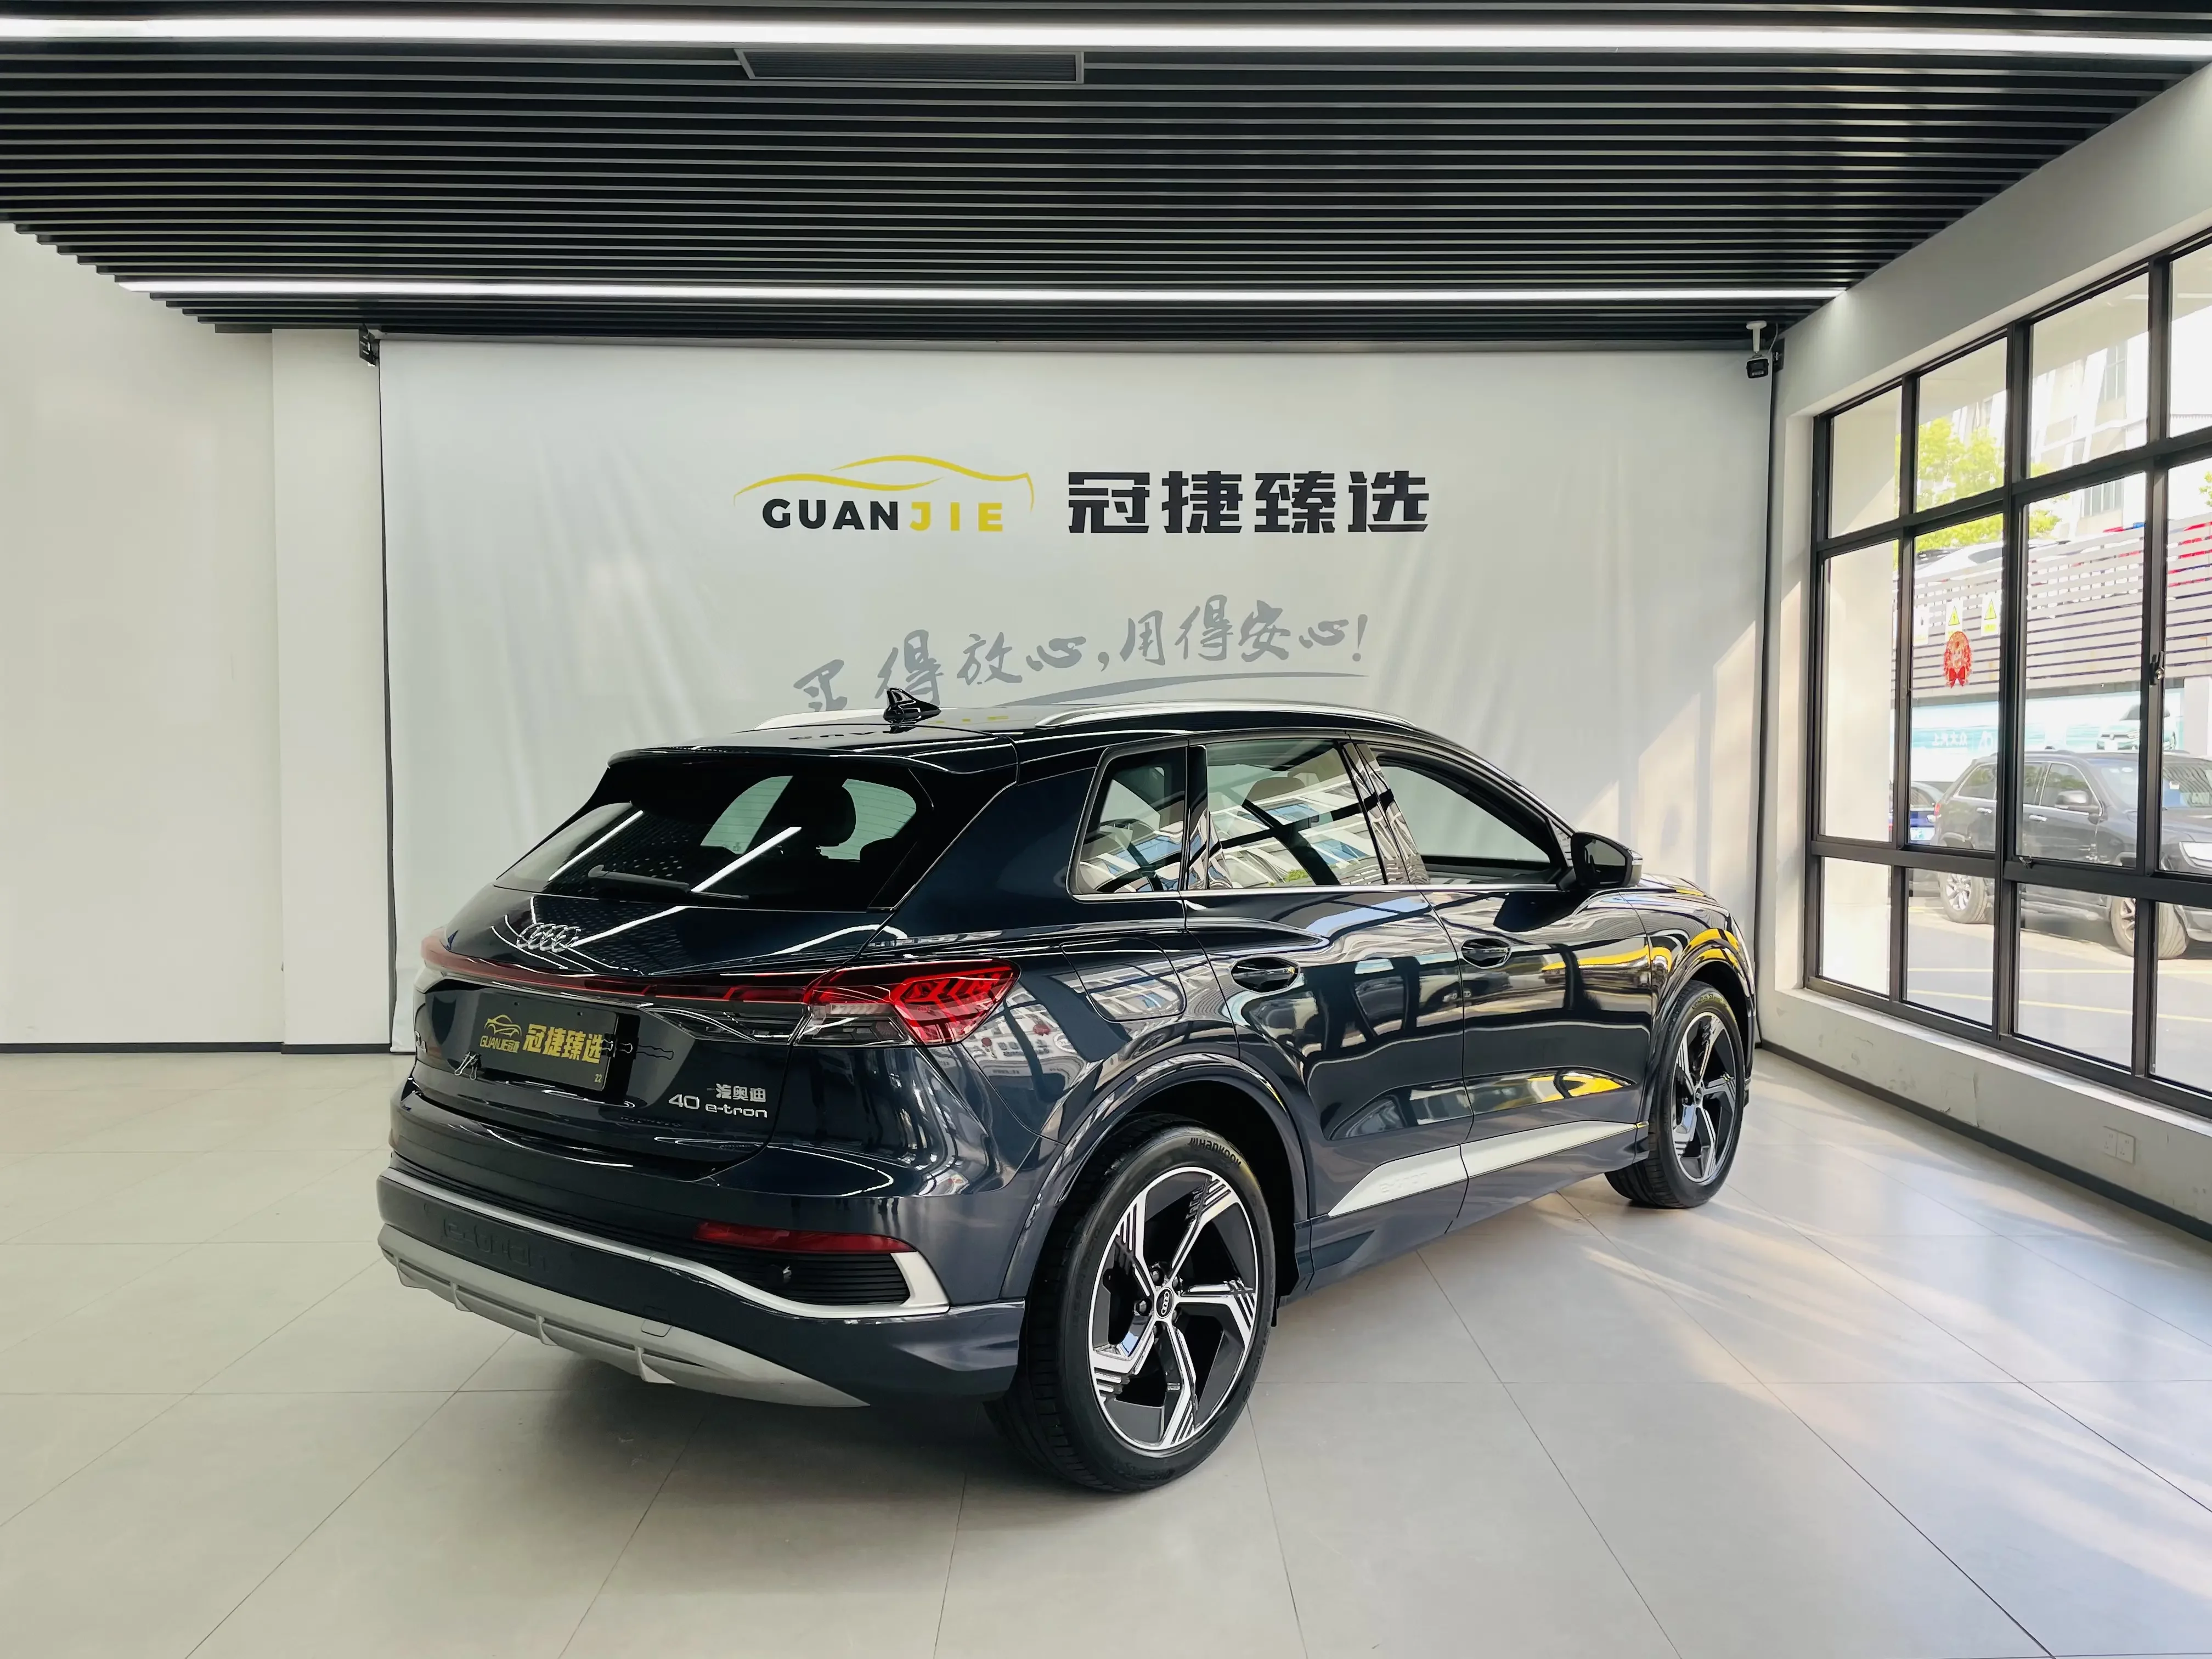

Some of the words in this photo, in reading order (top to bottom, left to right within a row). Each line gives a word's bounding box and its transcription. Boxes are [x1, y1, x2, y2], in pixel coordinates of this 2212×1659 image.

[762, 498, 1003, 532] GUANJIE
[1068, 471, 1429, 533] 冠捷臻选
[522, 1023, 603, 1064] 冠捷臻选
[668, 1094, 700, 1110] 40
[705, 1104, 768, 1118] e-tron
